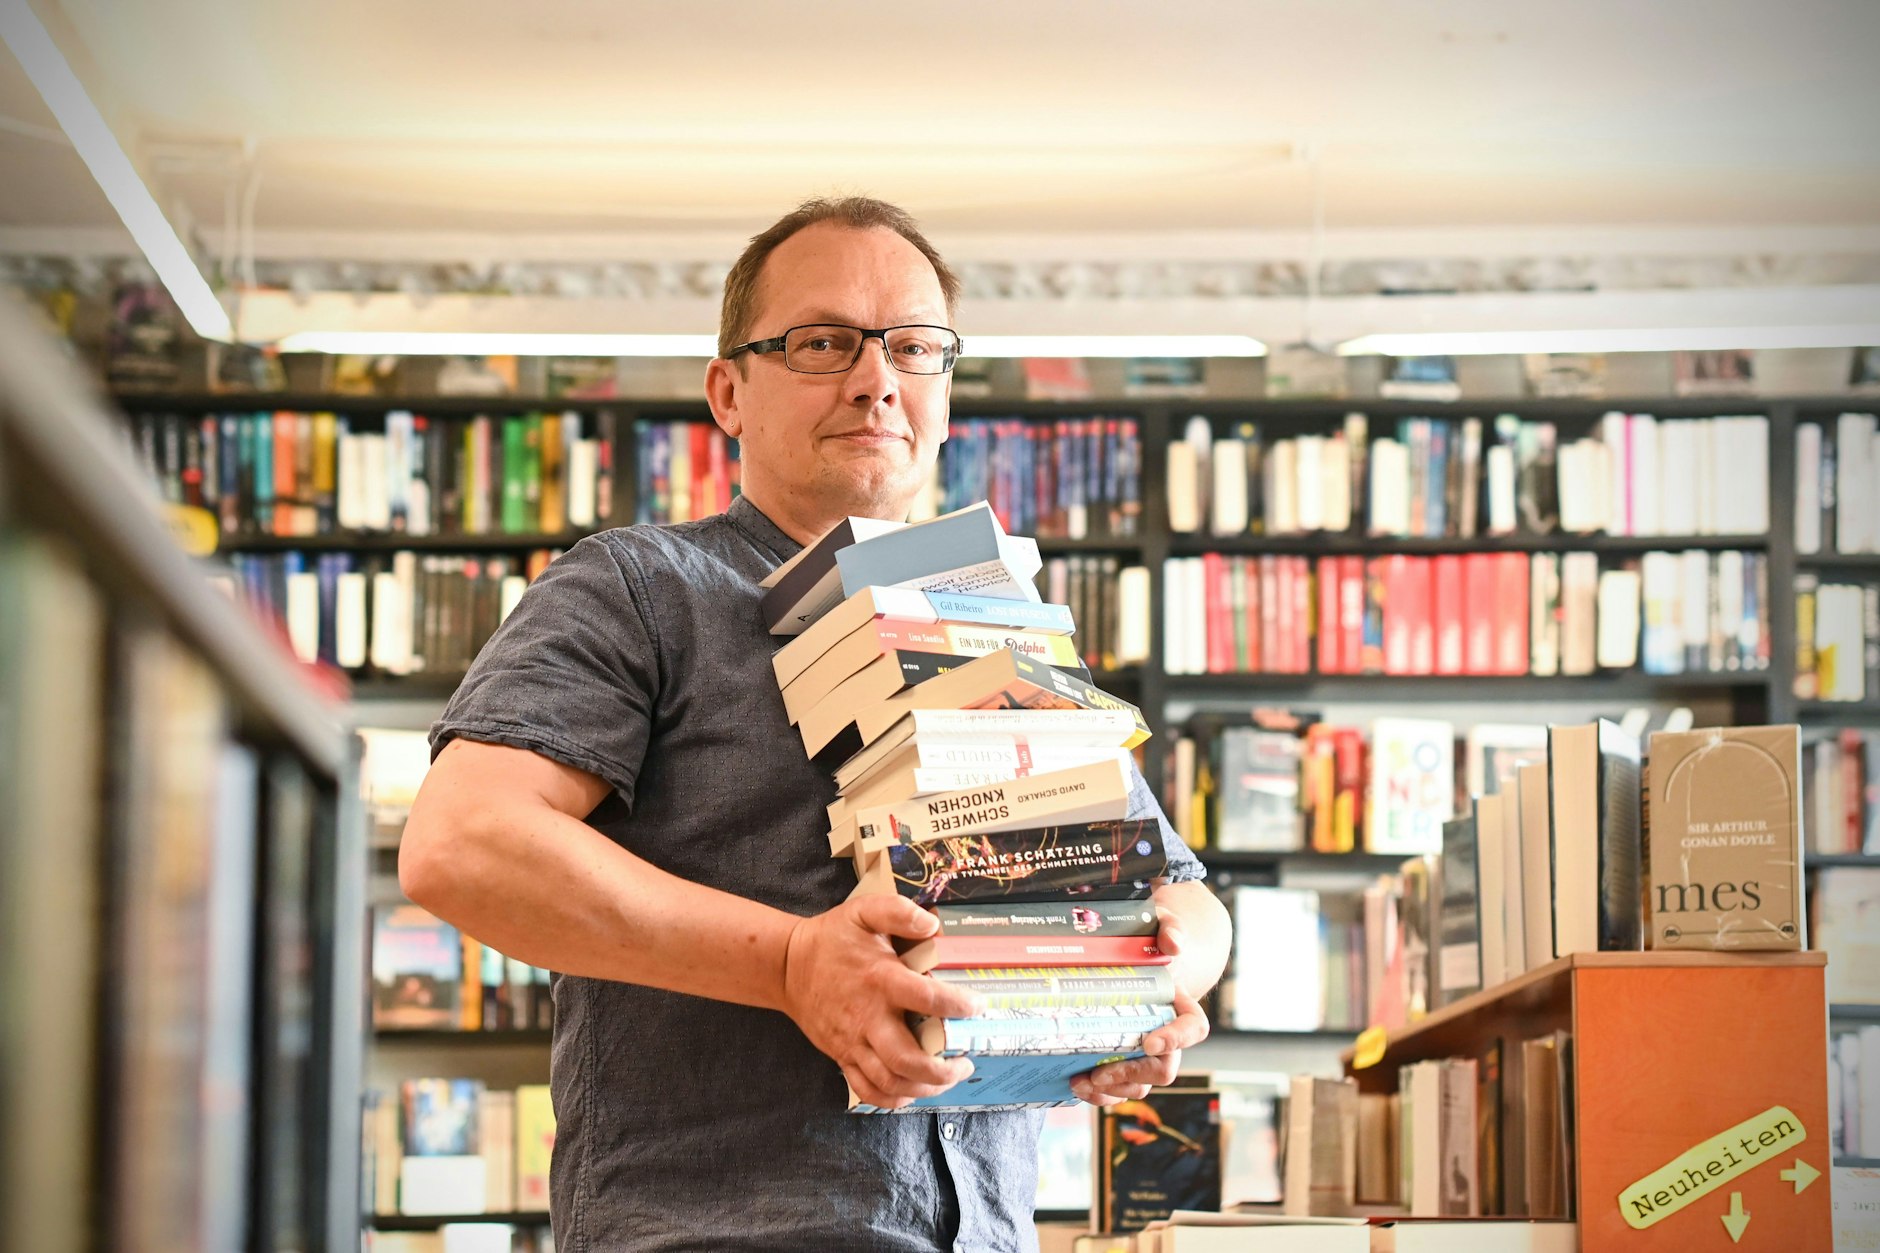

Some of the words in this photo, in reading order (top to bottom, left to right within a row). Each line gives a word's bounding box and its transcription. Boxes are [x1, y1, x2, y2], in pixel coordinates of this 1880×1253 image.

[953, 571, 1009, 590] Samuel
[958, 566, 1007, 582] Leben
[958, 576, 1012, 594] Hawley
[940, 600, 953, 613] Gil
[954, 602, 983, 615] Ribeiro
[908, 632, 922, 643] Lisa
[922, 634, 945, 645] Sandlin
[959, 637, 972, 649] EIN
[974, 638, 986, 650] JOB
[987, 638, 1000, 651] FÜR
[1003, 637, 1046, 656] Delpha
[944, 749, 1012, 762] SCHULD
[952, 772, 1009, 785] STRAFE
[1017, 787, 1058, 803] SCHALKO
[1059, 782, 1086, 796] DAVID
[927, 788, 1005, 816] KNOCHEN
[930, 805, 1010, 833] SCHWERE
[1687, 822, 1710, 834] SIR
[1712, 820, 1768, 833] ARTHUR
[1680, 835, 1728, 848] CONAN
[1730, 833, 1776, 846] DOYLE
[956, 852, 1009, 869] FRANK
[1014, 842, 1103, 865] SCHÄTZING
[942, 870, 957, 881] DIE
[960, 865, 1011, 878] TYRANNEI
[1014, 862, 1033, 874] DES
[1035, 853, 1119, 872] SCHMETTERLINGS
[1656, 879, 1762, 914] mes
[1010, 914, 1044, 926] Schätzing
[1044, 915, 1067, 925] Frank
[1106, 914, 1137, 922] GOLDMANN
[1063, 980, 1094, 989] SAYERS
[1109, 980, 1151, 989] DOROTHY
[1631, 1116, 1797, 1220] Neuheiten
